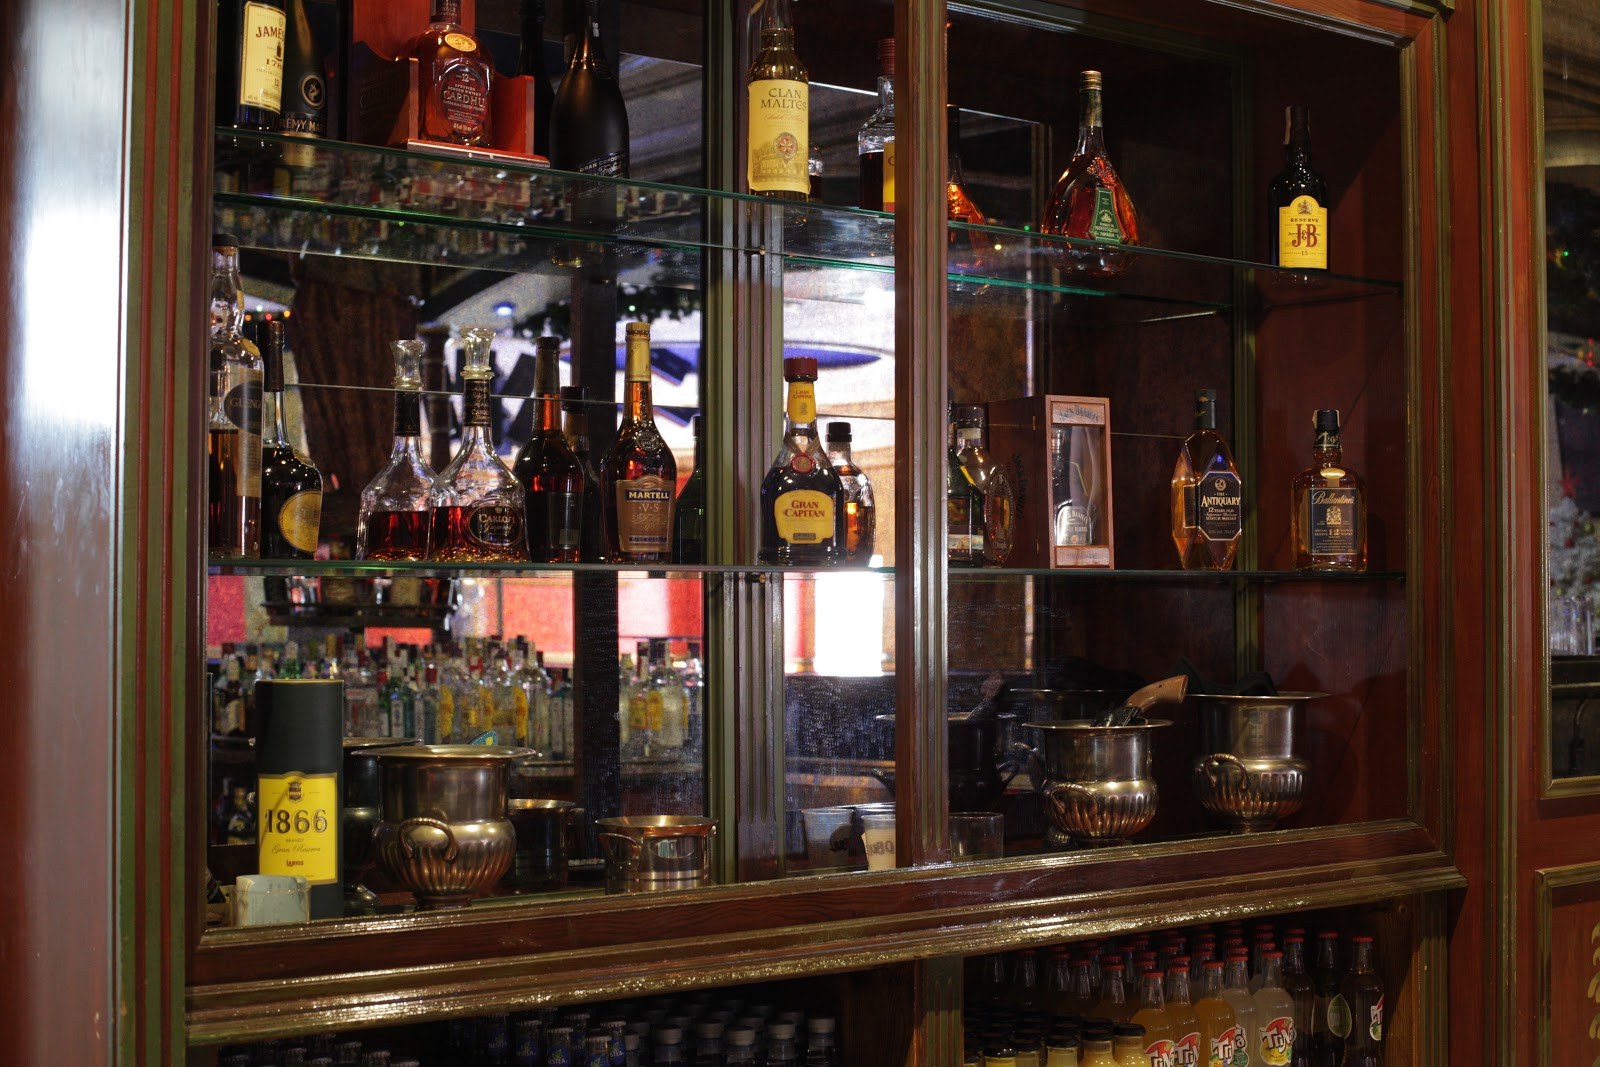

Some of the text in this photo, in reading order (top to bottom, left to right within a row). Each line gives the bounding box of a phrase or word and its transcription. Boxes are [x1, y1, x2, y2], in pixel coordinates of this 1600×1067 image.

[442, 90, 486, 108] CARDHU
[768, 87, 803, 99] CLAN
[1291, 223, 1318, 248] J&B
[628, 491, 669, 499] MARTELL
[1200, 495, 1240, 507] ANTIQUARY
[791, 500, 819, 509] GRAN
[783, 508, 825, 517] CAPITAN
[264, 809, 328, 834] 1866
[286, 859, 304, 867] LARIOS
